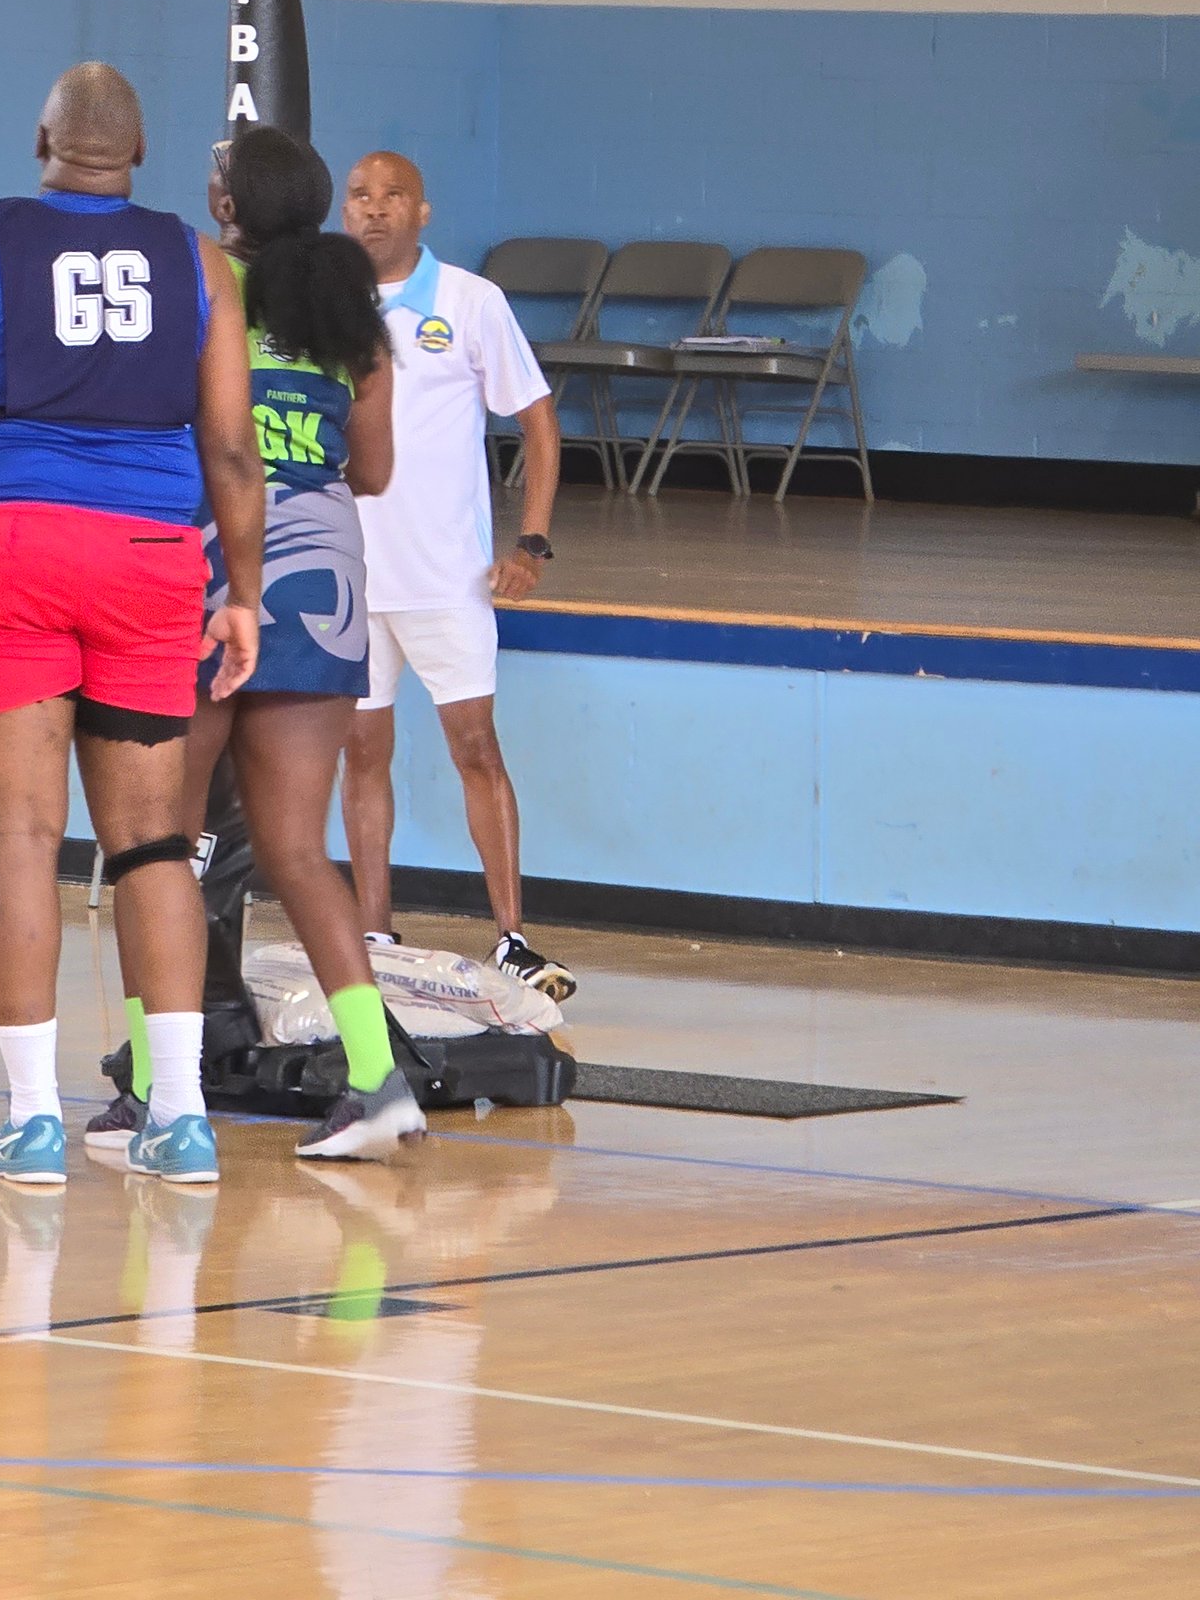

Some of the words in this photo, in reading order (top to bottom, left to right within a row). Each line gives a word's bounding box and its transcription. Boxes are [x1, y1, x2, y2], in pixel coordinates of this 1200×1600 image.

[52, 250, 153, 346] GS
[266, 389, 308, 404] PANTHERS
[251, 403, 325, 465] GK
